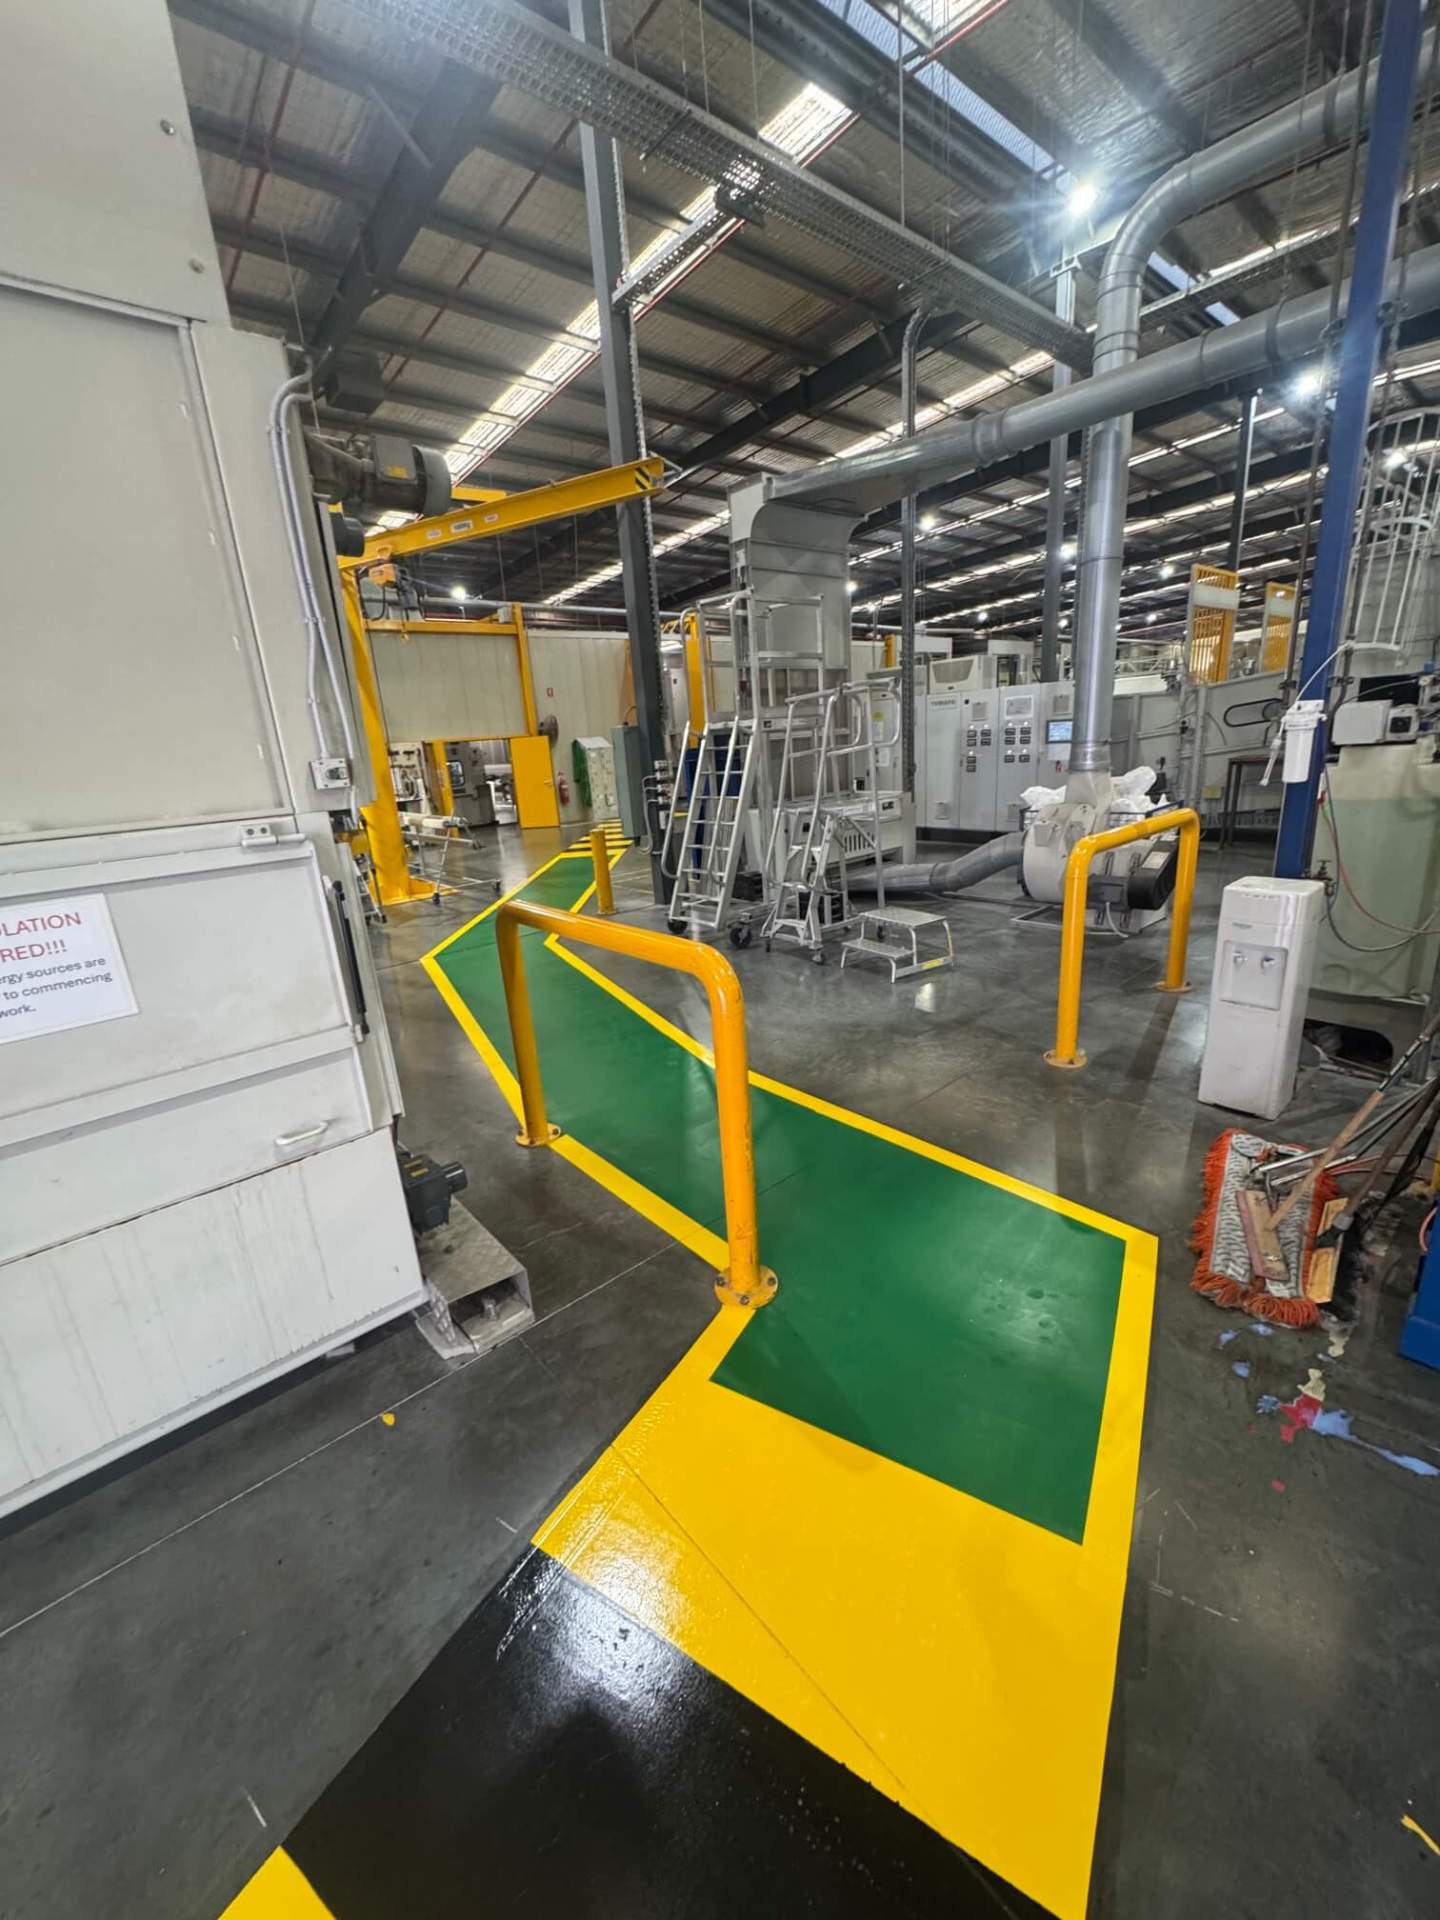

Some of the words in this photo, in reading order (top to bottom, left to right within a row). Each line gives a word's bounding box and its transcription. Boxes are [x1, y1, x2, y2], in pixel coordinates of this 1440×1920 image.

[0, 912, 82, 937] LATION
[0, 939, 67, 963] RED!!!
[26, 962, 82, 979] sources
[85, 957, 106, 968] are
[3, 991, 19, 1000] to
[22, 972, 113, 997] commencing
